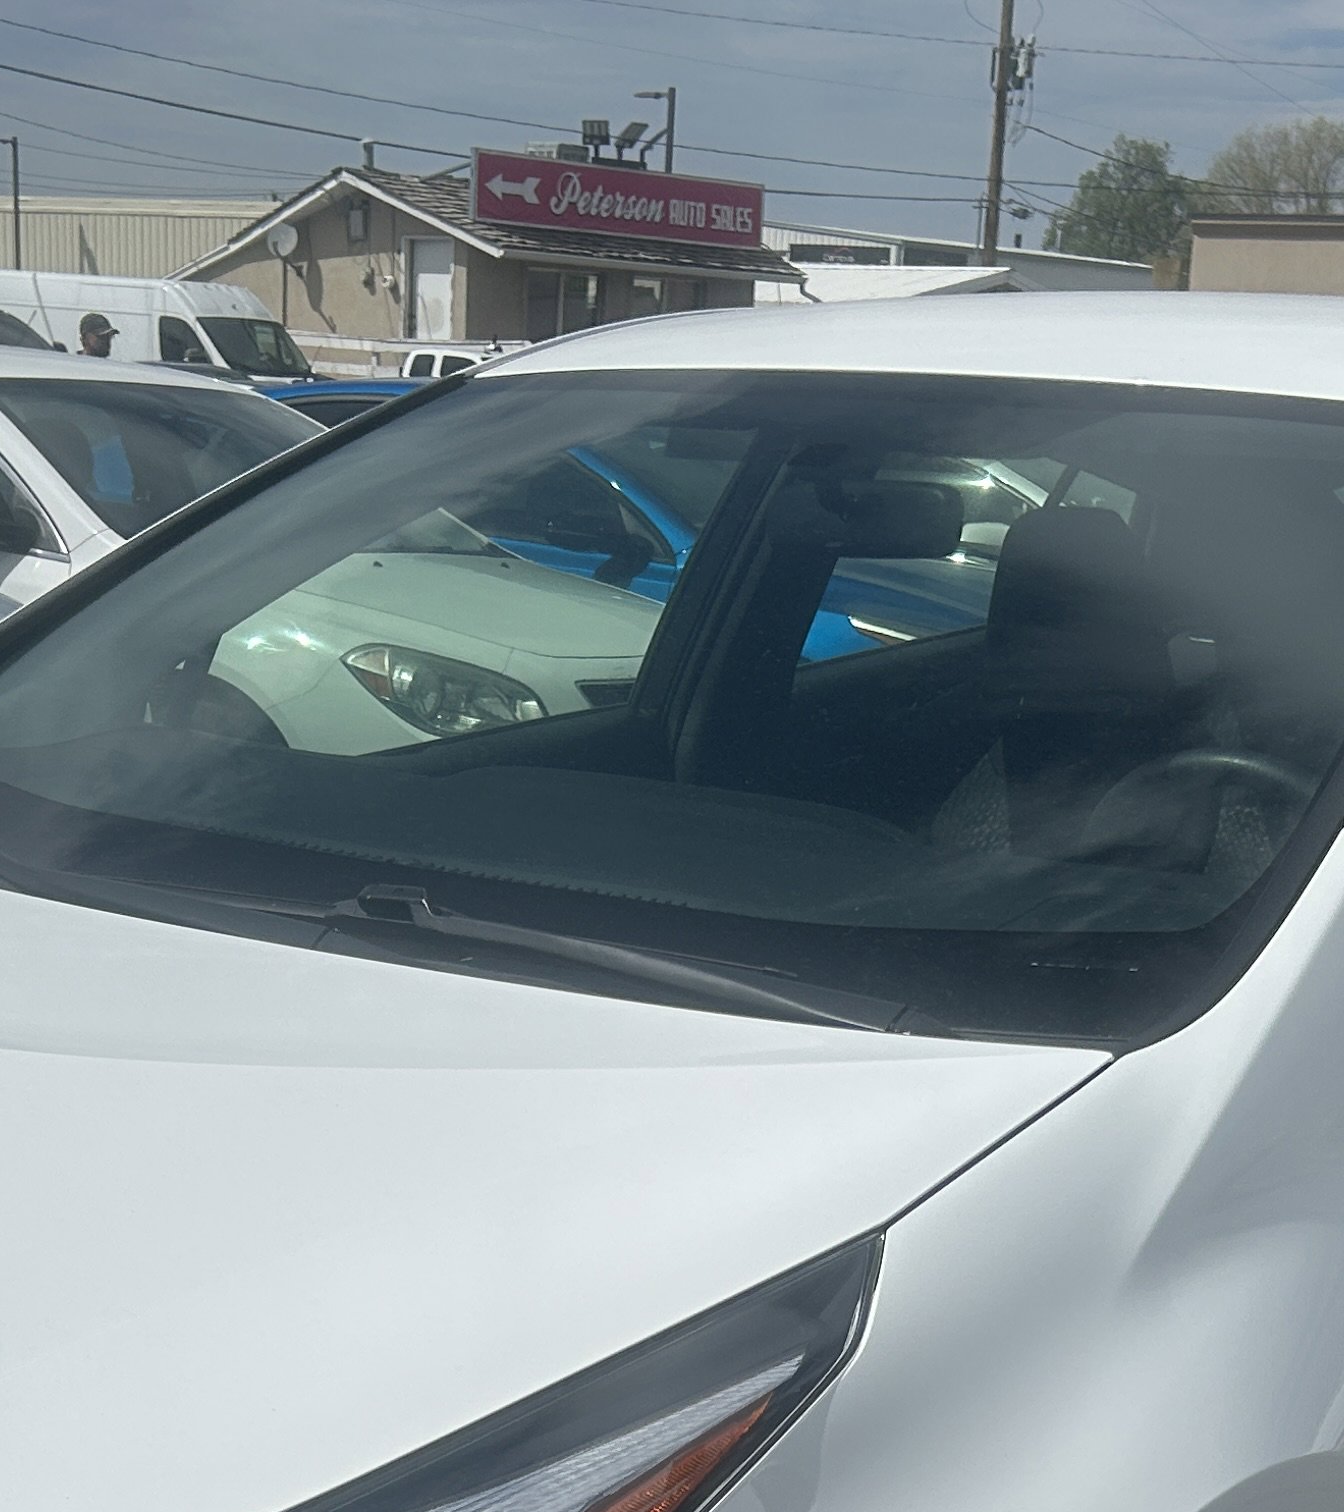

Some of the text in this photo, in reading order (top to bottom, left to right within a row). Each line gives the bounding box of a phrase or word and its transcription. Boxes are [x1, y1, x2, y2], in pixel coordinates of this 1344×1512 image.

[550, 171, 754, 233] Peterson AUTO SALES
